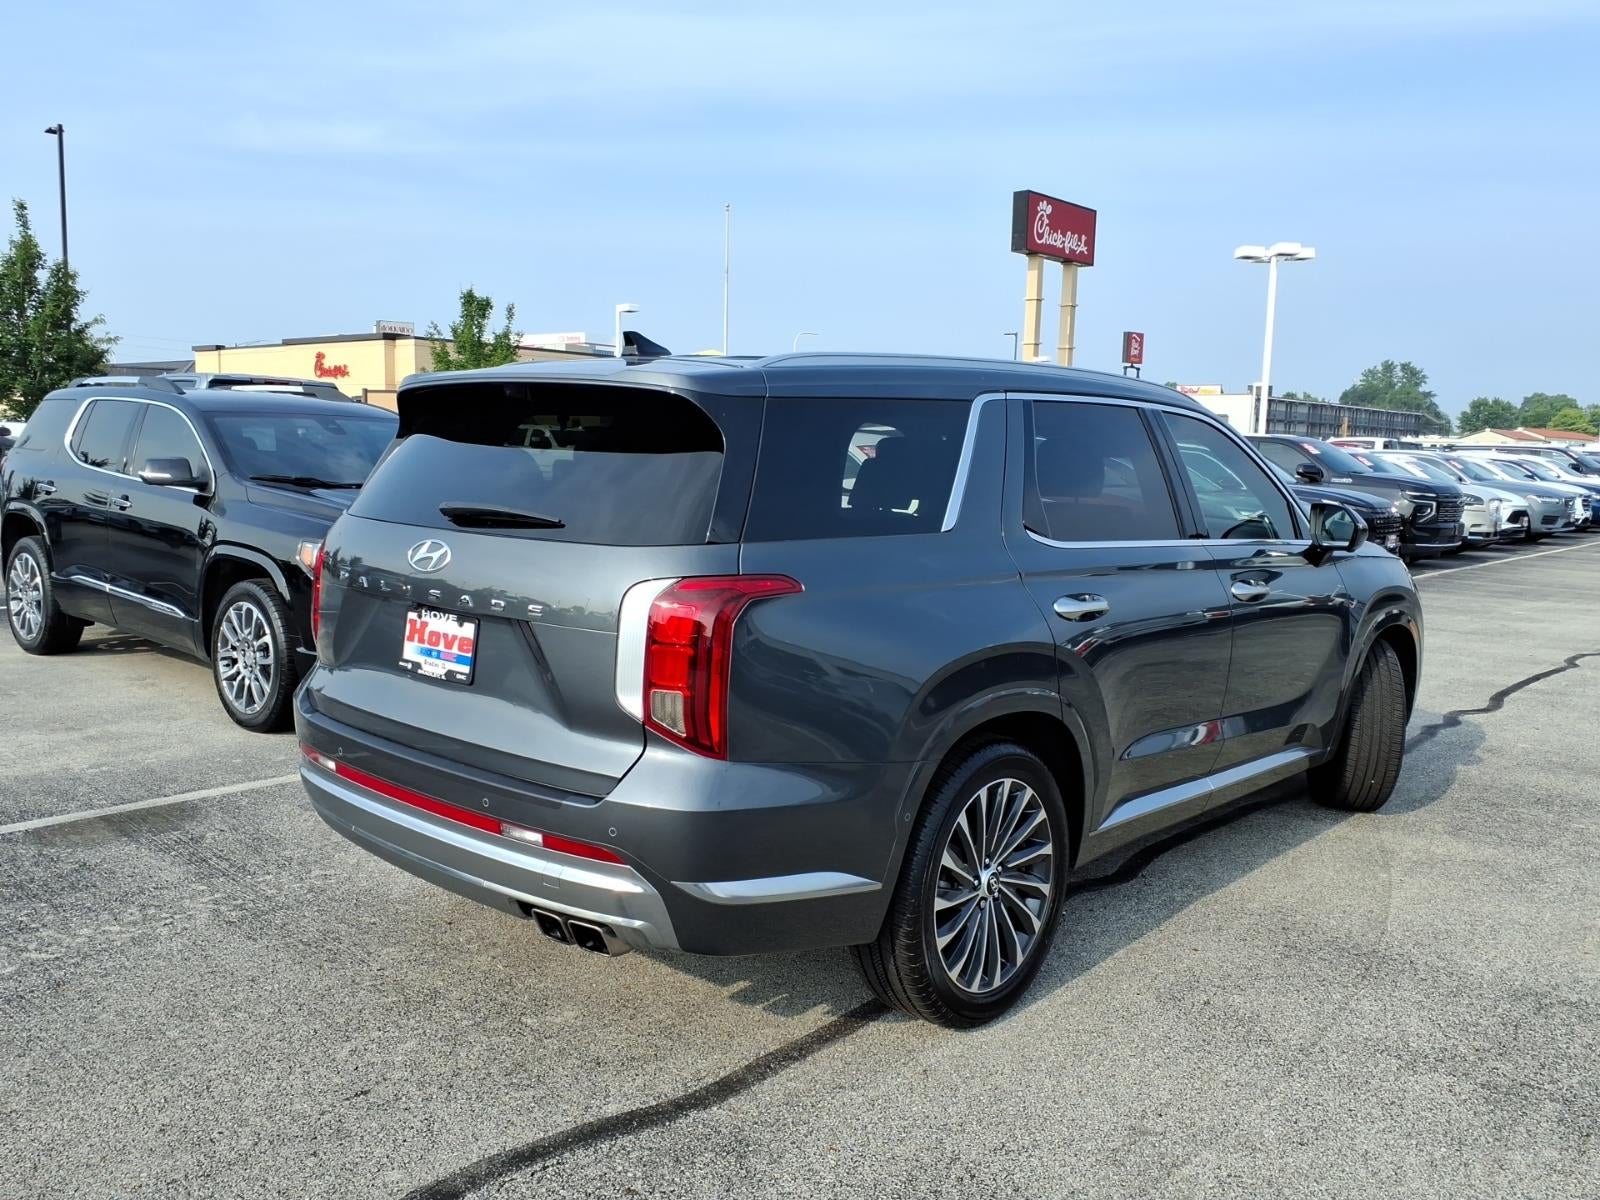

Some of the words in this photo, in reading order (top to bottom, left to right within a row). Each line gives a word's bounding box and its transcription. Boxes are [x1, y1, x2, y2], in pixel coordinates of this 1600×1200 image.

[1034, 201, 1088, 254] Chick-fil-A
[421, 609, 458, 622] HOVE
[406, 618, 474, 655] Hove
